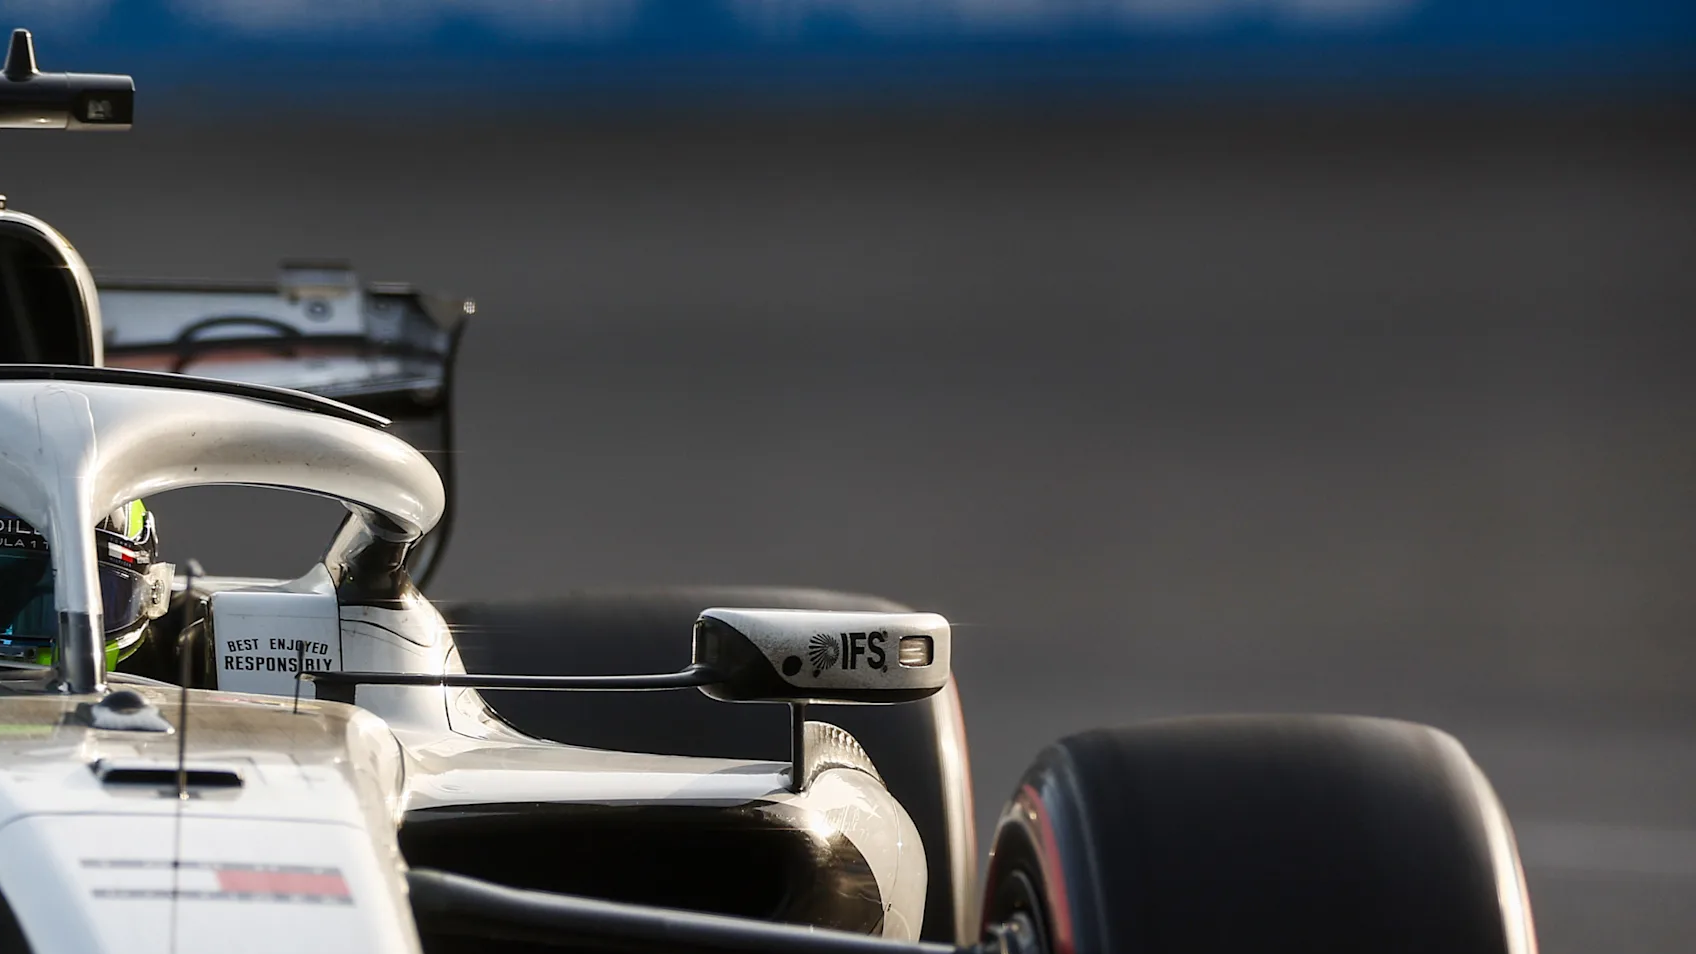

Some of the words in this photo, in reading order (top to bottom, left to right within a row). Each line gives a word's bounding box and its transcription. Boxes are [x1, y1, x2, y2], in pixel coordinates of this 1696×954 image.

[30, 540, 37, 548] 1
[227, 638, 259, 652] BEST
[269, 638, 328, 655] ENJOYED
[841, 631, 887, 670] IFS
